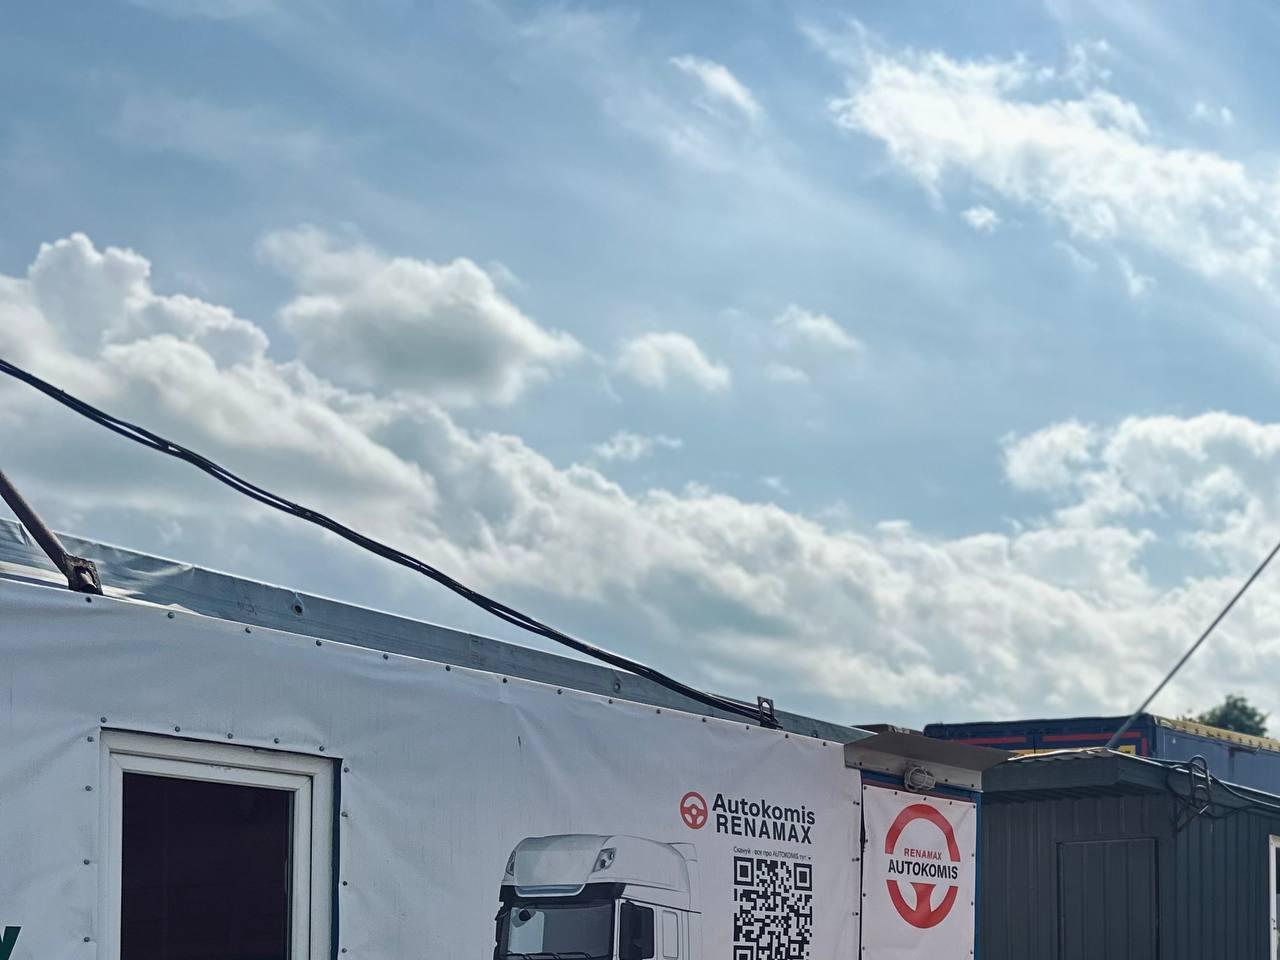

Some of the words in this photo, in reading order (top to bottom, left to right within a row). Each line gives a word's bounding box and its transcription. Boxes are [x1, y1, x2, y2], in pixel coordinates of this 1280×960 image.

[712, 793, 816, 825] Autokomis
[716, 813, 812, 844] RENAMAX
[904, 847, 942, 860] RENAMAX
[888, 859, 959, 880] AUTOKOMIS
